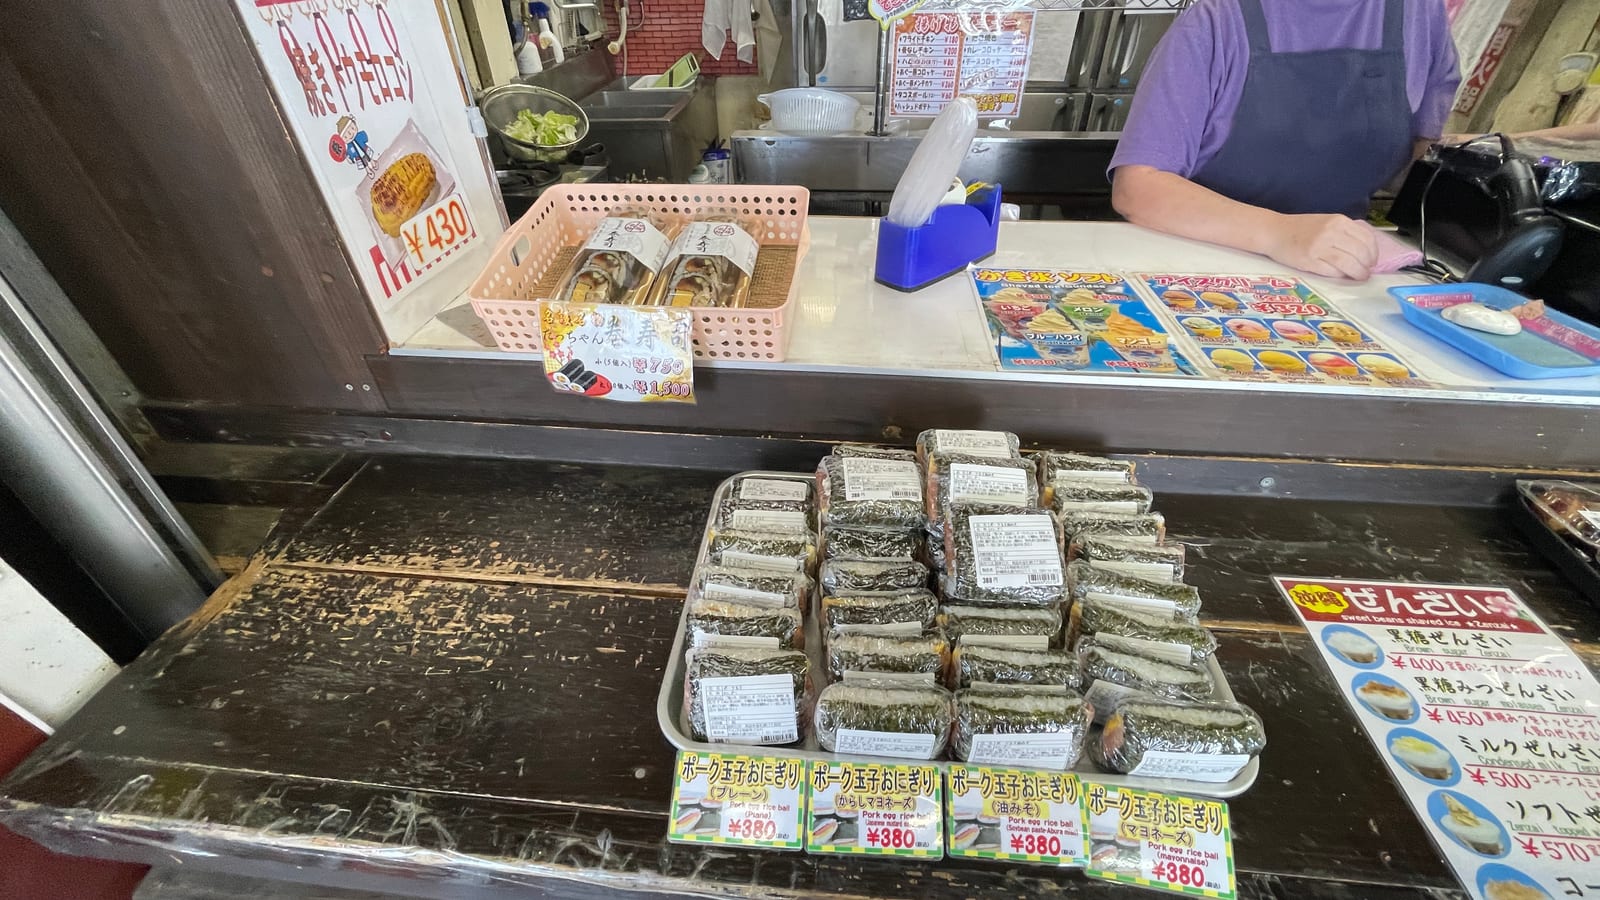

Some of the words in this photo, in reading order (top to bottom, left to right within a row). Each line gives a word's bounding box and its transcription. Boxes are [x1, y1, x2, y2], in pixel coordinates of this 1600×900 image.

[402, 200, 468, 264] ¥430
[977, 270, 1056, 282] かき氷
[1057, 272, 1123, 284] ソフト
[1153, 275, 1296, 288] アイスクリーム
[1026, 333, 1082, 341] ブルーハワイ
[633, 357, 684, 376] ¥750
[634, 379, 690, 396] ¥1,500
[1293, 590, 1344, 607] 沖縄
[1342, 587, 1489, 618] ぜんざい
[1341, 614, 1371, 622] sweet
[1374, 615, 1402, 624] beans
[1406, 618, 1445, 627] shaved
[1446, 620, 1461, 628] ice
[1386, 628, 1513, 648] 黒糖ぜんざい
[1404, 644, 1434, 652] Brown
[1442, 648, 1467, 656] sugar
[1477, 648, 1511, 658] Zenzai
[1386, 655, 1445, 672] ¥400
[1414, 676, 1576, 702] 黒糖みつぜんざい
[1425, 695, 1455, 704] Brown
[1464, 699, 1489, 707] sugar
[1422, 706, 1484, 727] ¥450
[682, 757, 800, 788] ポーク玉子おにぎり
[1478, 755, 1535, 769] Condensed
[1537, 760, 1564, 771] milk
[813, 764, 935, 795] ポーク玉子おにぎり
[952, 771, 1077, 801] ポーク玉子おにぎり
[1463, 767, 1531, 789] ¥500
[762, 803, 776, 811] rice
[835, 795, 916, 810] (からしマヨネーズ)
[991, 802, 1041, 818] (油みそ)
[1090, 787, 1223, 834] ポーク玉子おにぎり
[900, 812, 914, 820] rice
[728, 819, 776, 840] ¥380
[867, 827, 915, 848] ¥380
[1121, 823, 1194, 848] (マヨネーズ)
[1011, 833, 1061, 856] ¥380
[1148, 841, 1167, 851] Pork
[1169, 846, 1183, 854] egg
[1187, 848, 1202, 857] rice
[1204, 850, 1219, 860] ball
[1514, 836, 1590, 862] ¥570
[1157, 851, 1209, 867] (mayonnaise)
[1152, 859, 1205, 888] ¥380
